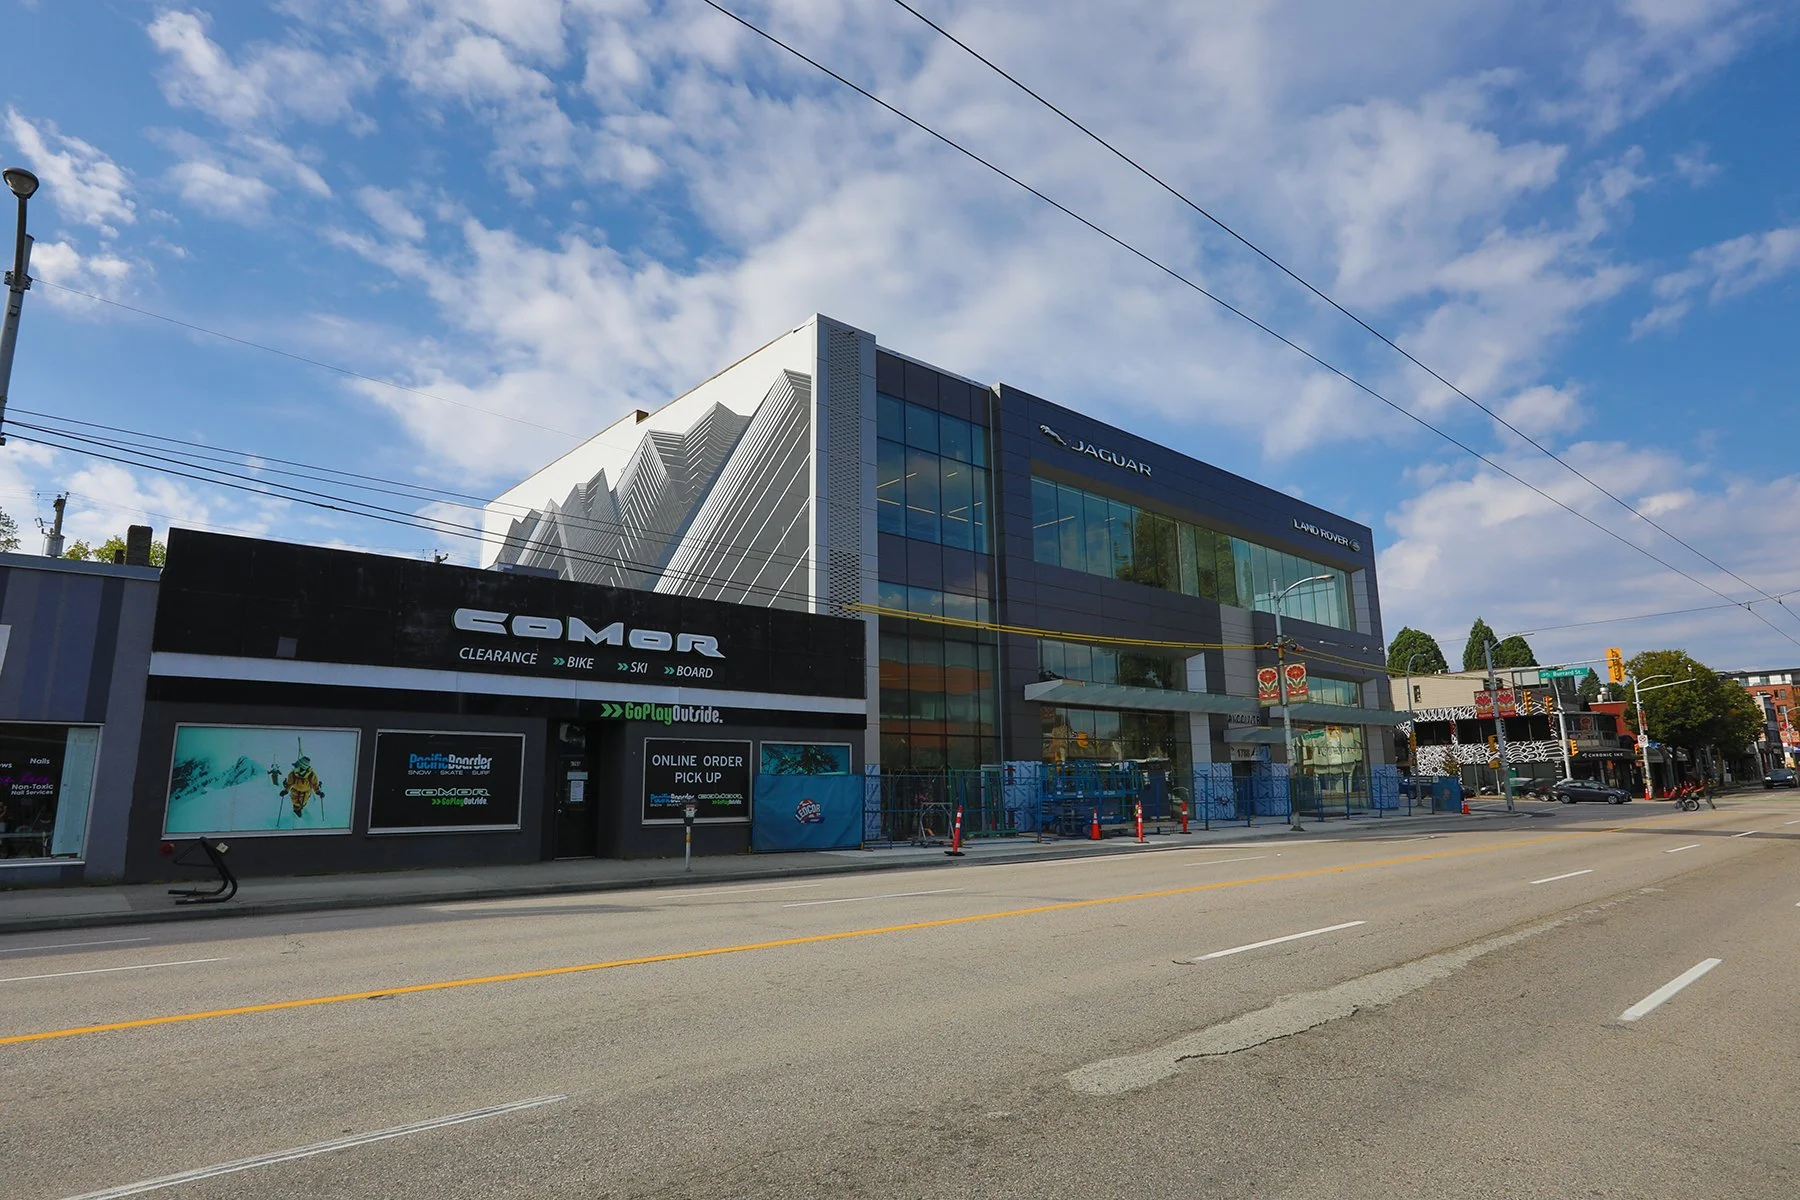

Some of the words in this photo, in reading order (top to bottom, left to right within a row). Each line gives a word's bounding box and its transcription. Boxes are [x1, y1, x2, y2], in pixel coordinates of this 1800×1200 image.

[1071, 440, 1152, 477] JAGUAR
[1293, 518, 1320, 536] LAND
[1320, 529, 1349, 547] ROVER
[453, 608, 727, 658] COMOR
[459, 647, 538, 665] CLEARANCE
[567, 656, 595, 669] BIKE
[630, 661, 649, 674] SKI
[676, 665, 714, 679] BOARD
[652, 754, 698, 767] ONLINE
[703, 755, 743, 767] ORDER
[675, 772, 703, 783] PICK
[705, 772, 722, 783] UP
[404, 787, 492, 797] COMOR
[795, 804, 821, 821] LEDCOR
